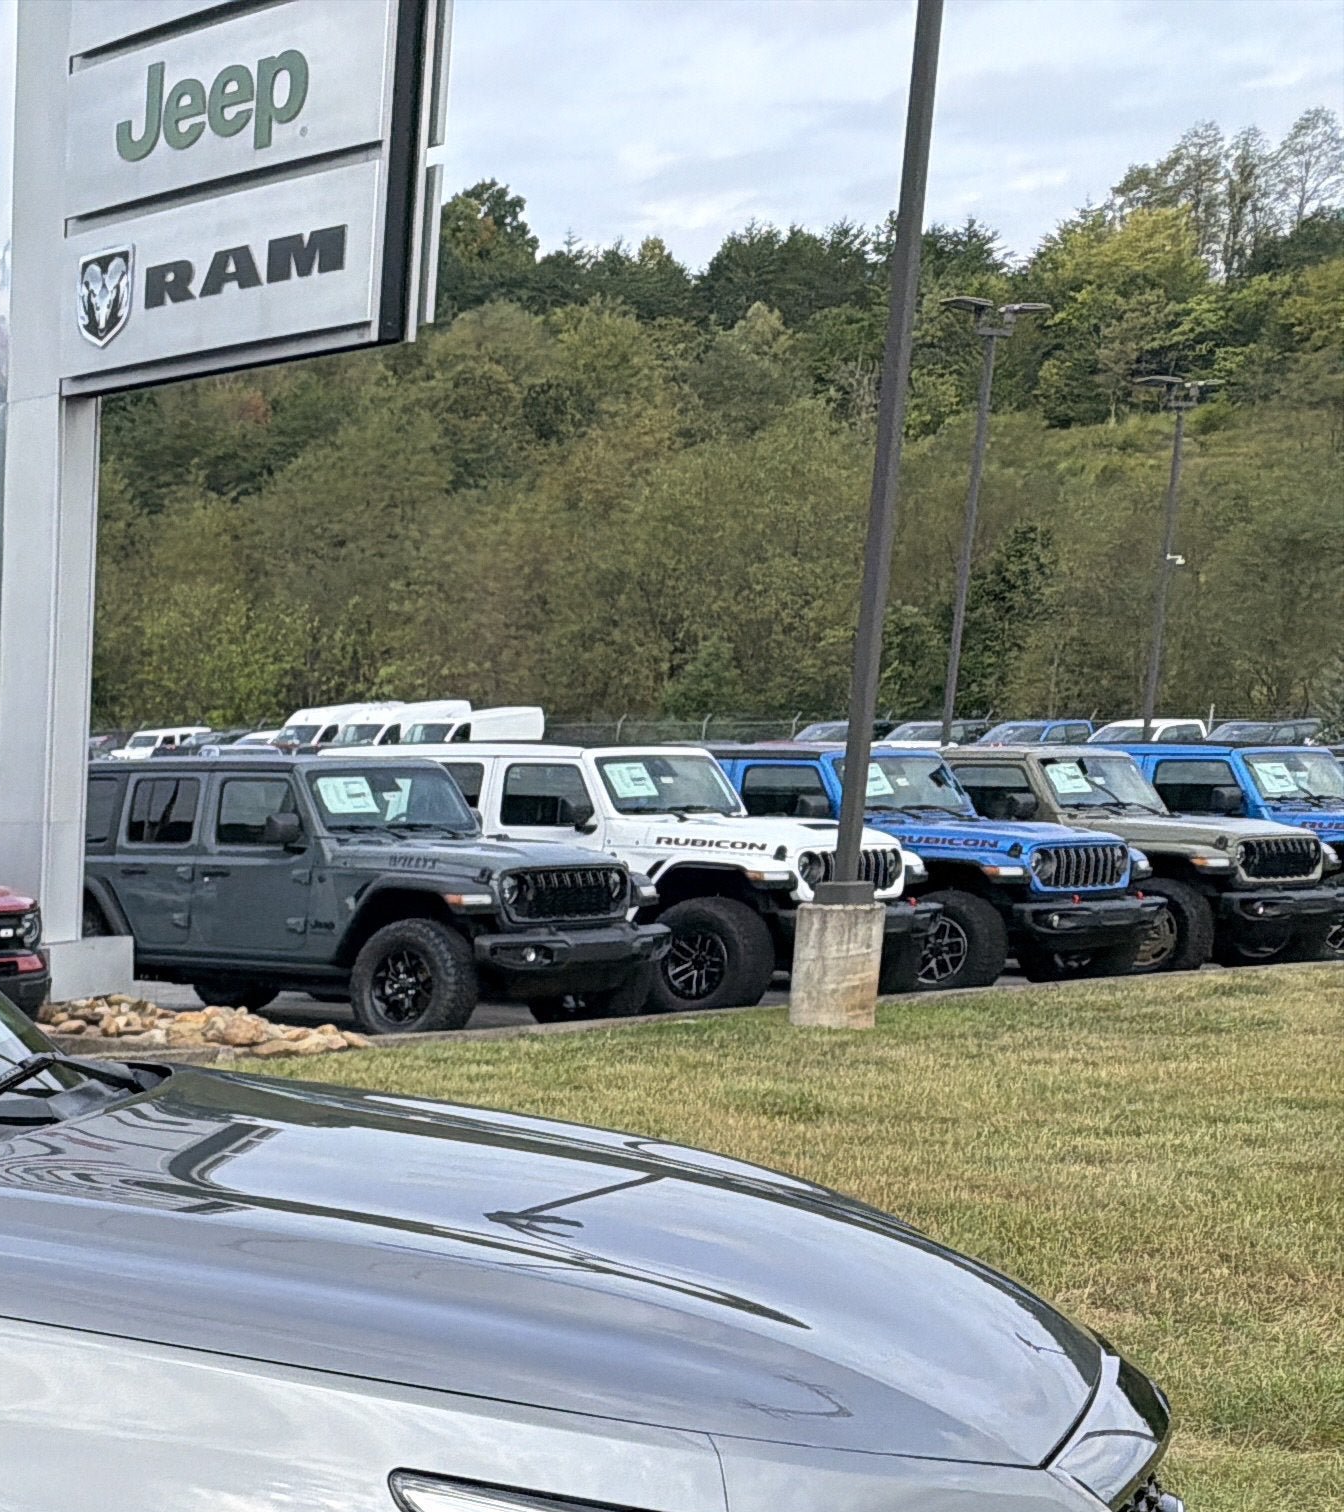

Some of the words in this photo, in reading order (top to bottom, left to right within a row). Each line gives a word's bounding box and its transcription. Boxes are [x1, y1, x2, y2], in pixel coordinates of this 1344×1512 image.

[115, 48, 310, 163] Jeep
[144, 224, 349, 310] RAM
[655, 836, 768, 851] RUBICON
